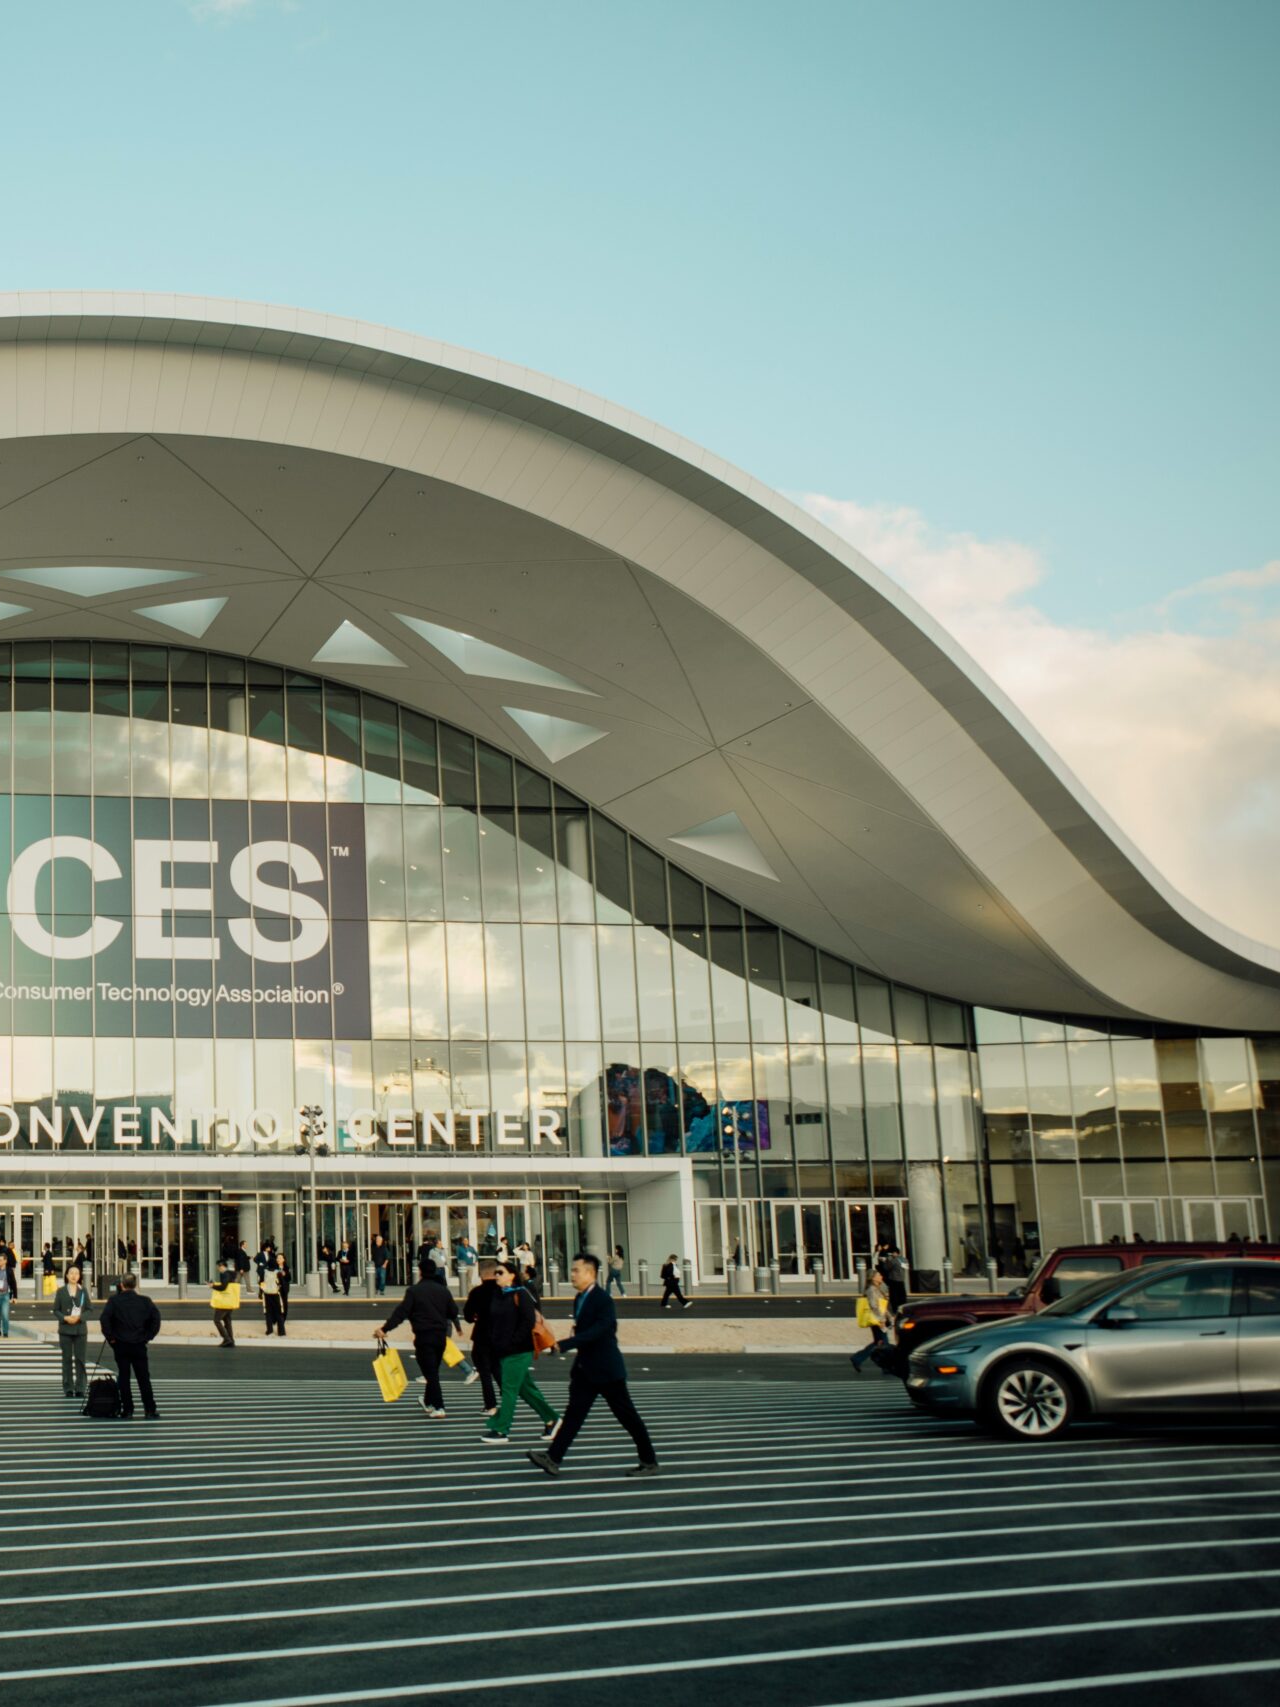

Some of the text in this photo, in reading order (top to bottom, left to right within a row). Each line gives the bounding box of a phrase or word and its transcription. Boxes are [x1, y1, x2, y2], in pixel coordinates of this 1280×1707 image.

[7, 835, 330, 963] CES
[96, 982, 212, 1007] Technology
[348, 1108, 562, 1146] CENTER
